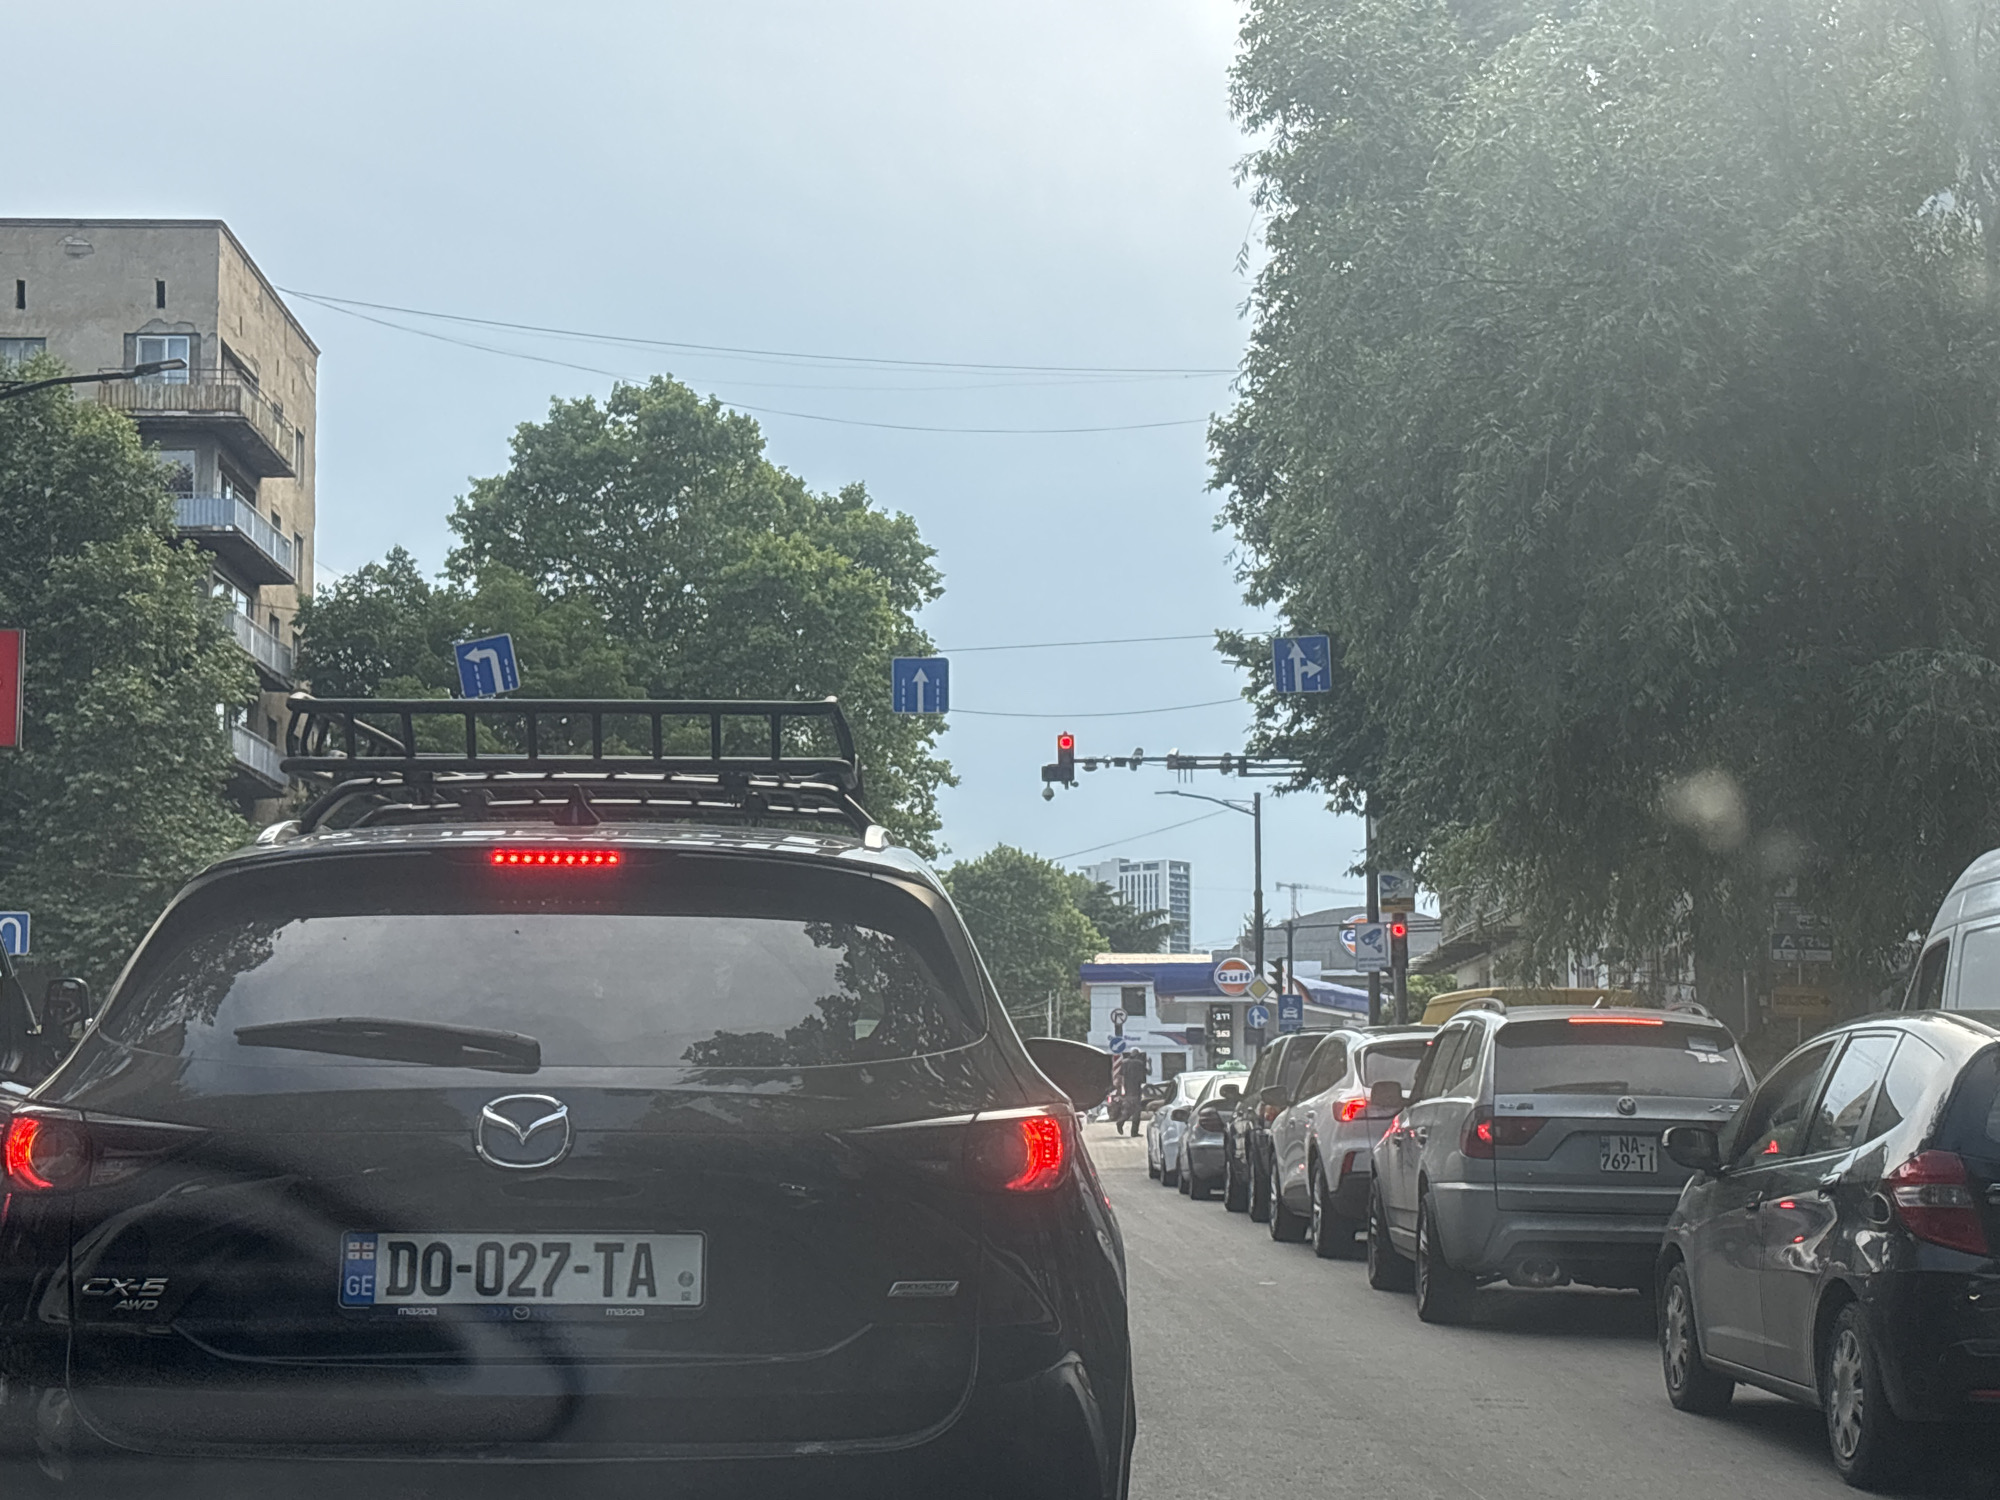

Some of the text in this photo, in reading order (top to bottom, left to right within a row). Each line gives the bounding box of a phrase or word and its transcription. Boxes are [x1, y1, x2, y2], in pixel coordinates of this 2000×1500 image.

[1217, 971, 1251, 982] Gulf
[1619, 1136, 1646, 1153] NA-
[385, 1241, 657, 1297] DO-027-TA
[82, 1277, 169, 1296] CX-5
[346, 1276, 373, 1296] GE
[113, 1300, 159, 1310] AWD
